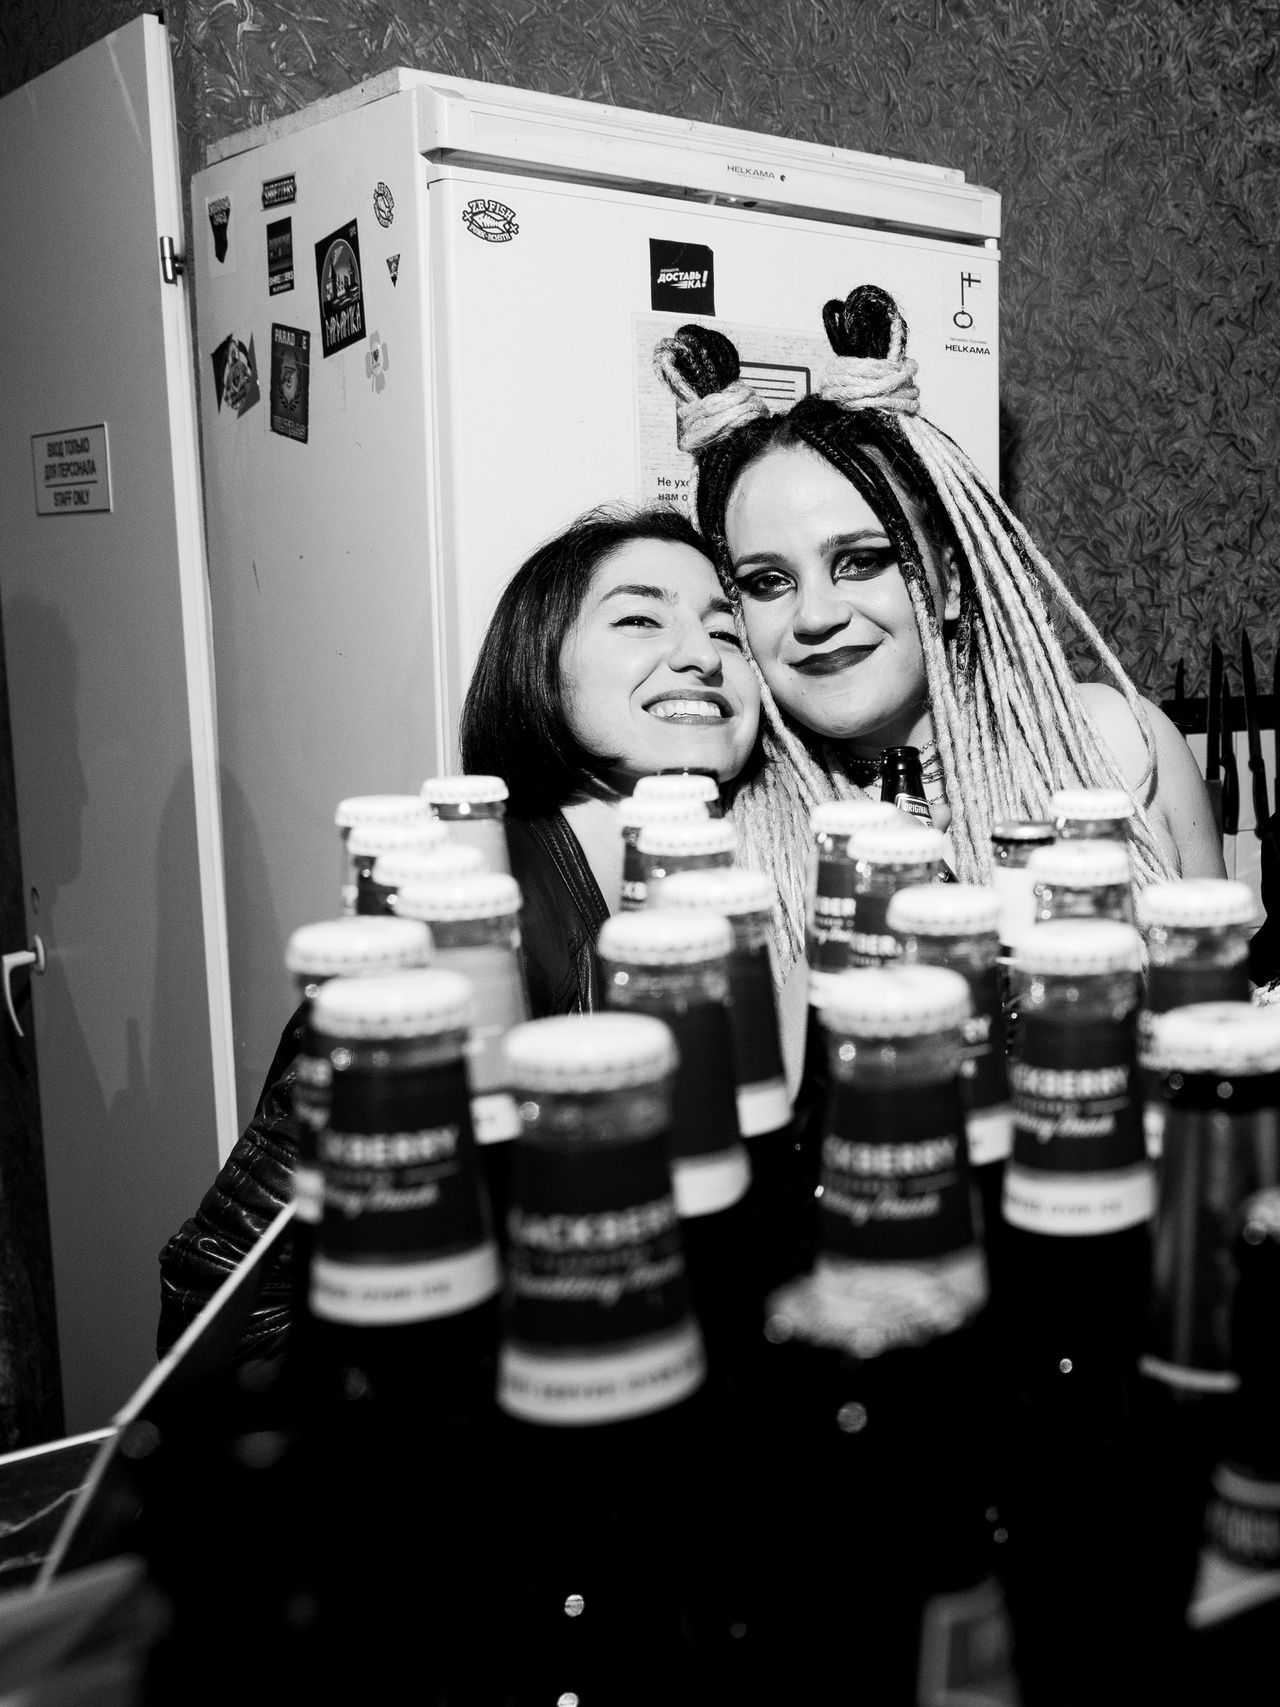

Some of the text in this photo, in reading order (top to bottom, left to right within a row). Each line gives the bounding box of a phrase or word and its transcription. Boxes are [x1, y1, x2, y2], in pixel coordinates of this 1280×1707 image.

[727, 165, 775, 179] HELKAMA
[469, 201, 515, 220] ZE FISH
[657, 271, 701, 284] ДОСТАВЬ
[945, 344, 991, 356] HELKAMA
[657, 476, 672, 487] Не
[658, 493, 679, 501] нам
